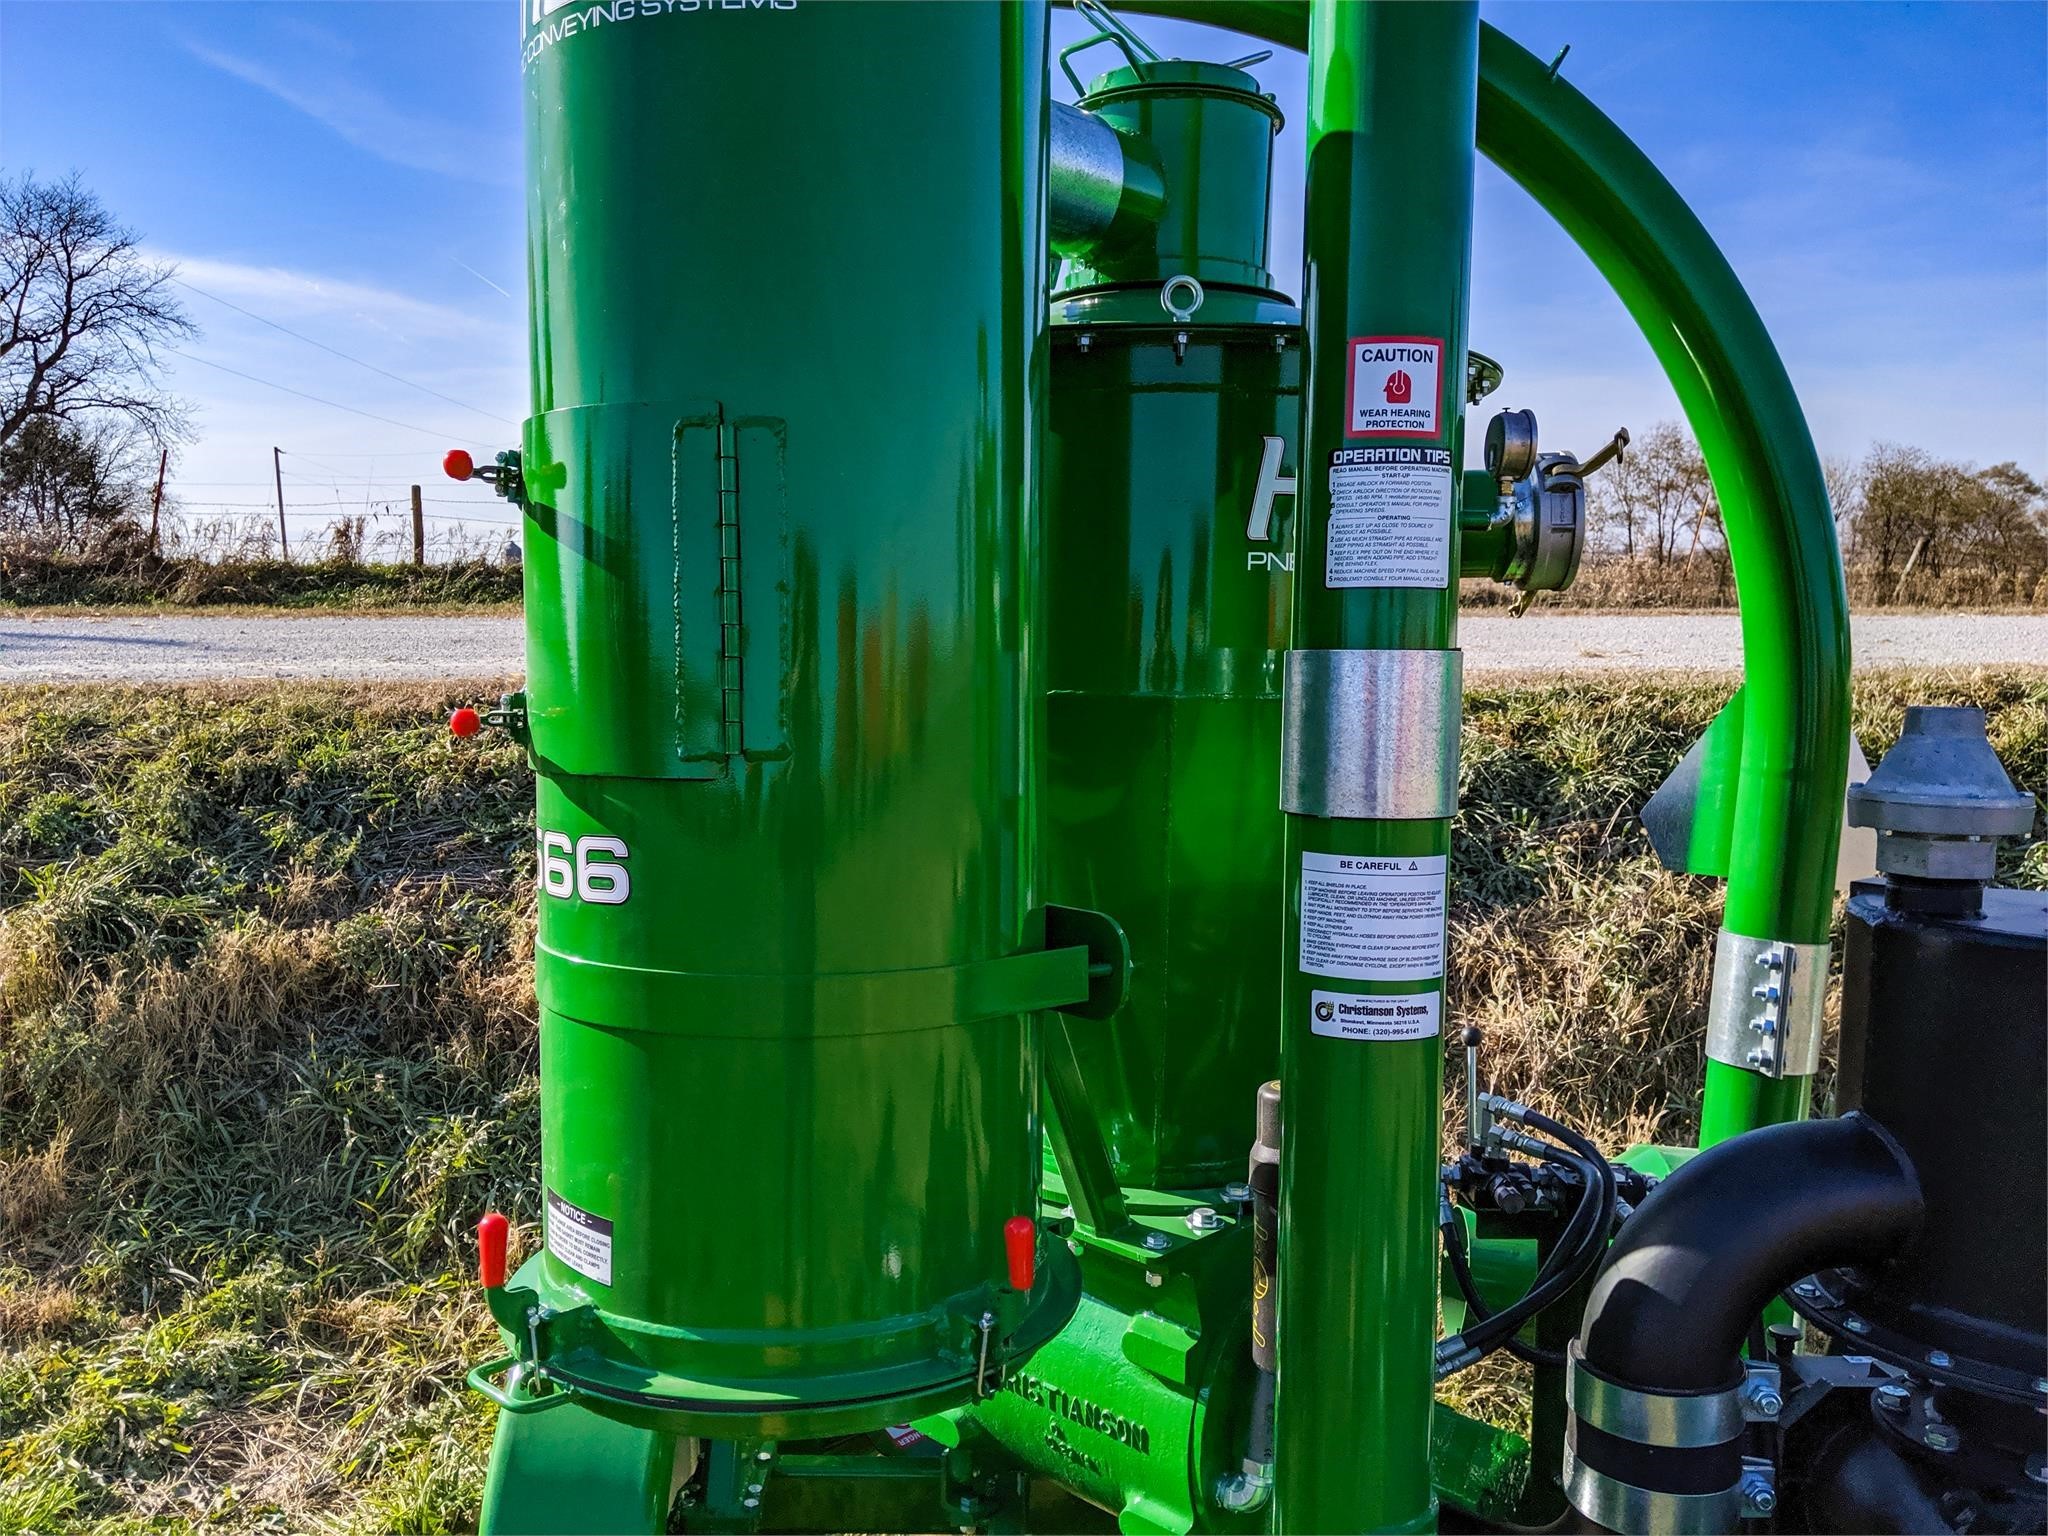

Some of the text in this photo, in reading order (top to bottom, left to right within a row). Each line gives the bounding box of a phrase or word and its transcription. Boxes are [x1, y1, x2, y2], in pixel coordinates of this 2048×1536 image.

[526, 1, 635, 64] CONVEYING
[1362, 348, 1433, 363] CAUTION
[1360, 409, 1430, 418] WEAR HEARING
[1366, 420, 1424, 428] PROTECTION
[1334, 448, 1450, 464] OPERATION TIPS
[1340, 860, 1402, 871] BE CAREFUL
[1339, 1004, 1429, 1017] Christianson Systems,
[1373, 1027, 1419, 1036] (320)-995-6141
[560, 1202, 586, 1225] NOTICE
[585, 1242, 600, 1253] REMAIN
[591, 1238, 610, 1248] CLOSING
[897, 1432, 921, 1446] NGER
